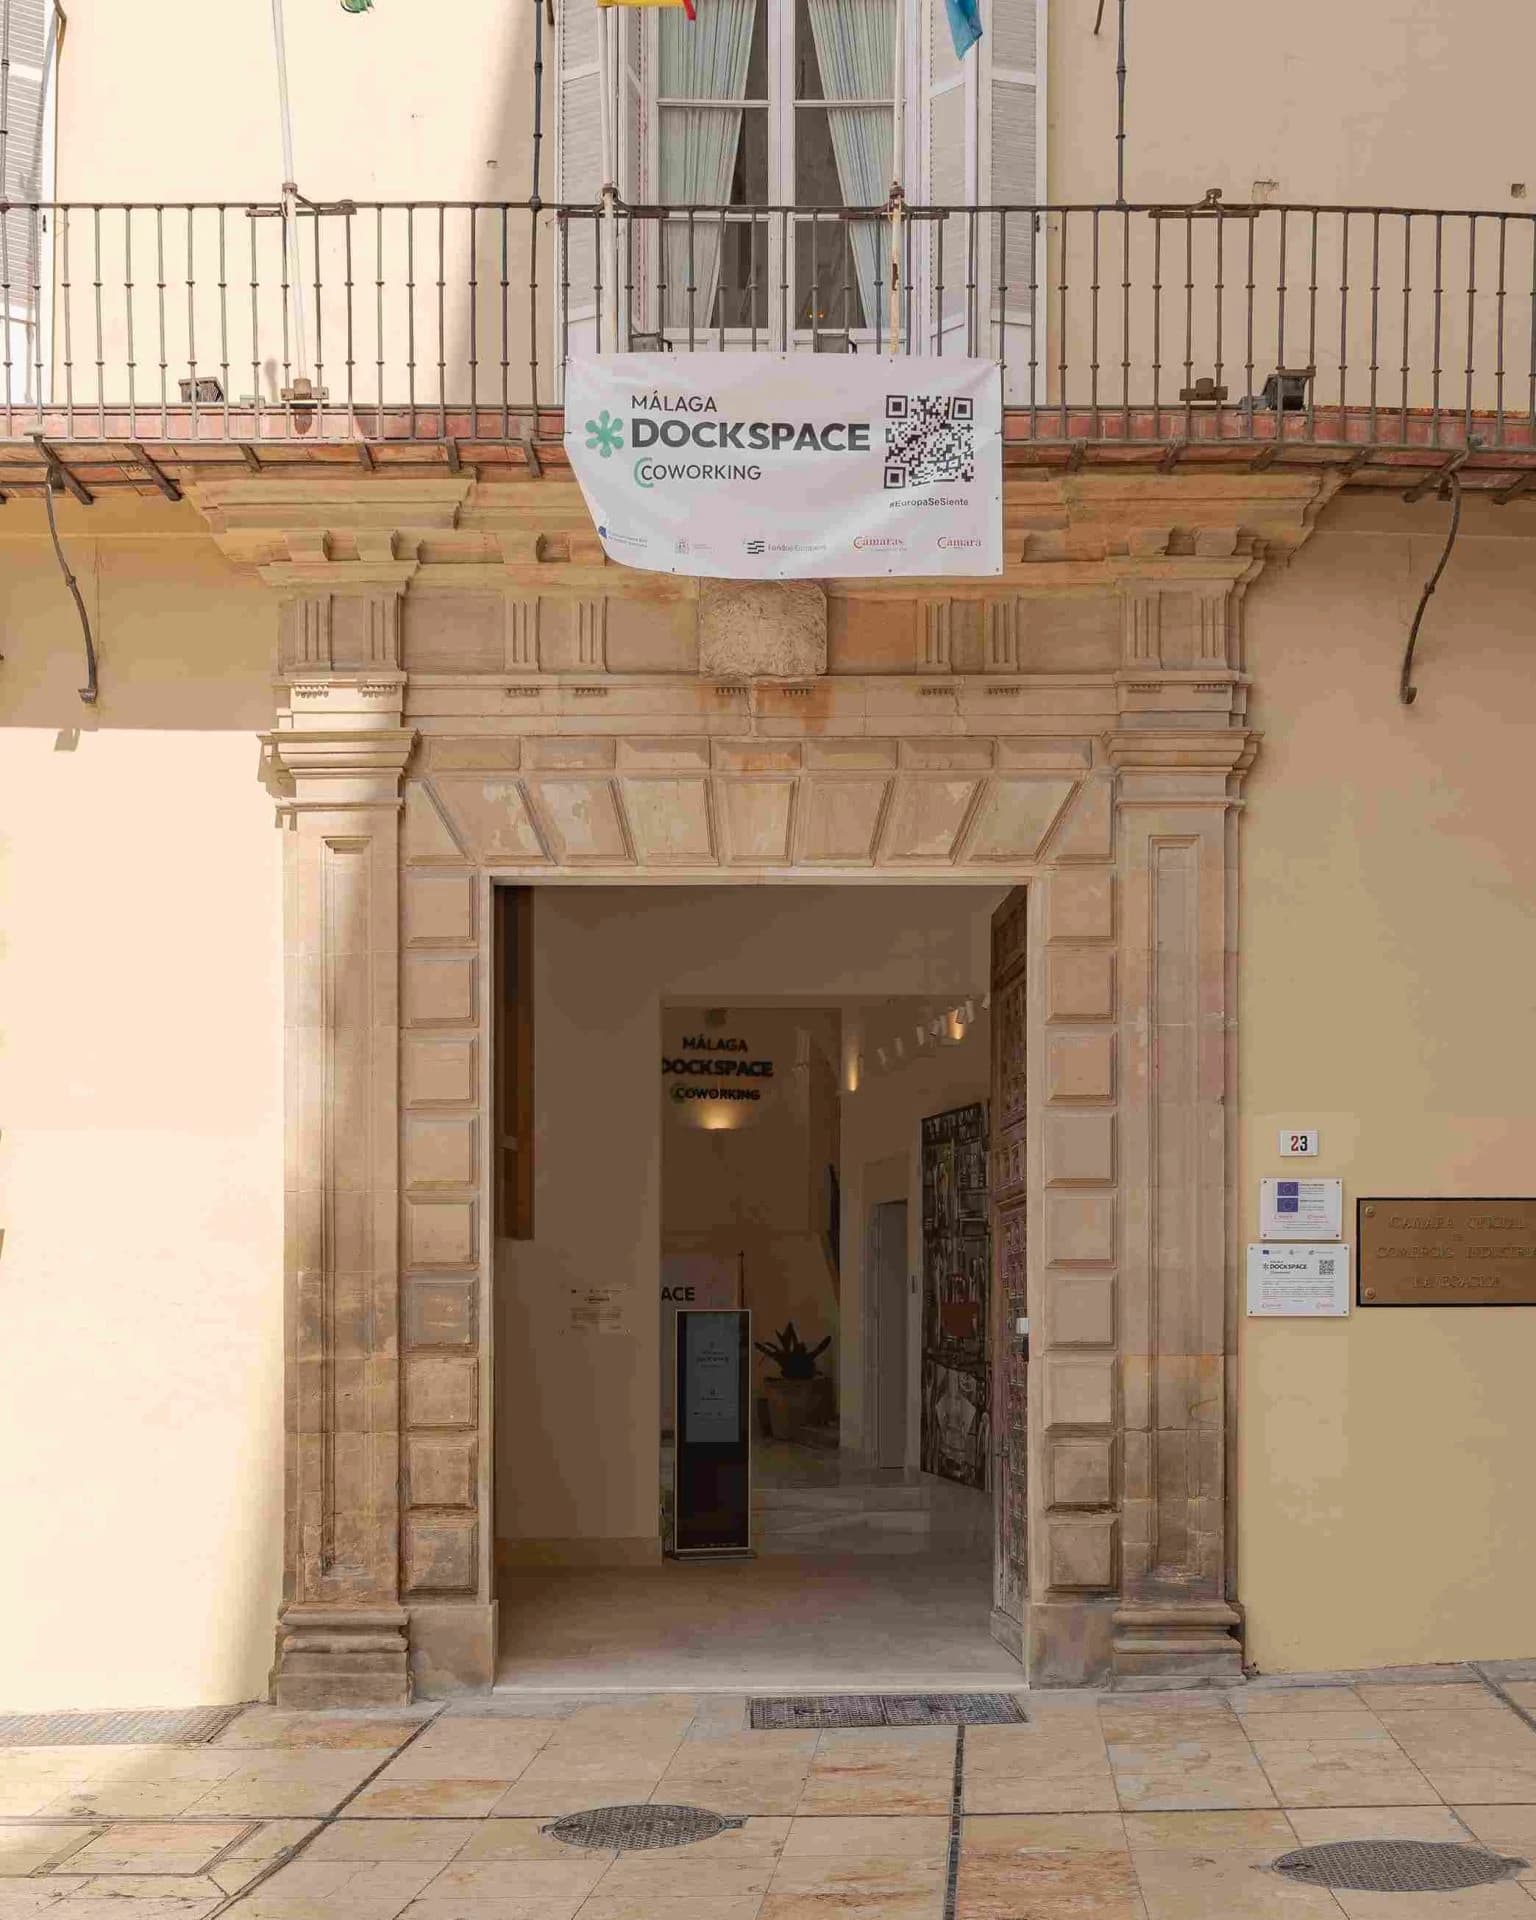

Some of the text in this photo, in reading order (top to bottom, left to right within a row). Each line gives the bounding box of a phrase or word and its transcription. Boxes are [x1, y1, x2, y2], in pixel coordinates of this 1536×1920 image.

[631, 390, 718, 413] MÁLAGA
[631, 418, 871, 452] DOCKSPACE
[638, 461, 762, 482] COWORKING
[889, 497, 969, 508] #EuropaSeSiente
[681, 1034, 749, 1052] MÁLAGA
[673, 1086, 761, 1101] COWORKING
[1290, 1135, 1308, 1152] 23
